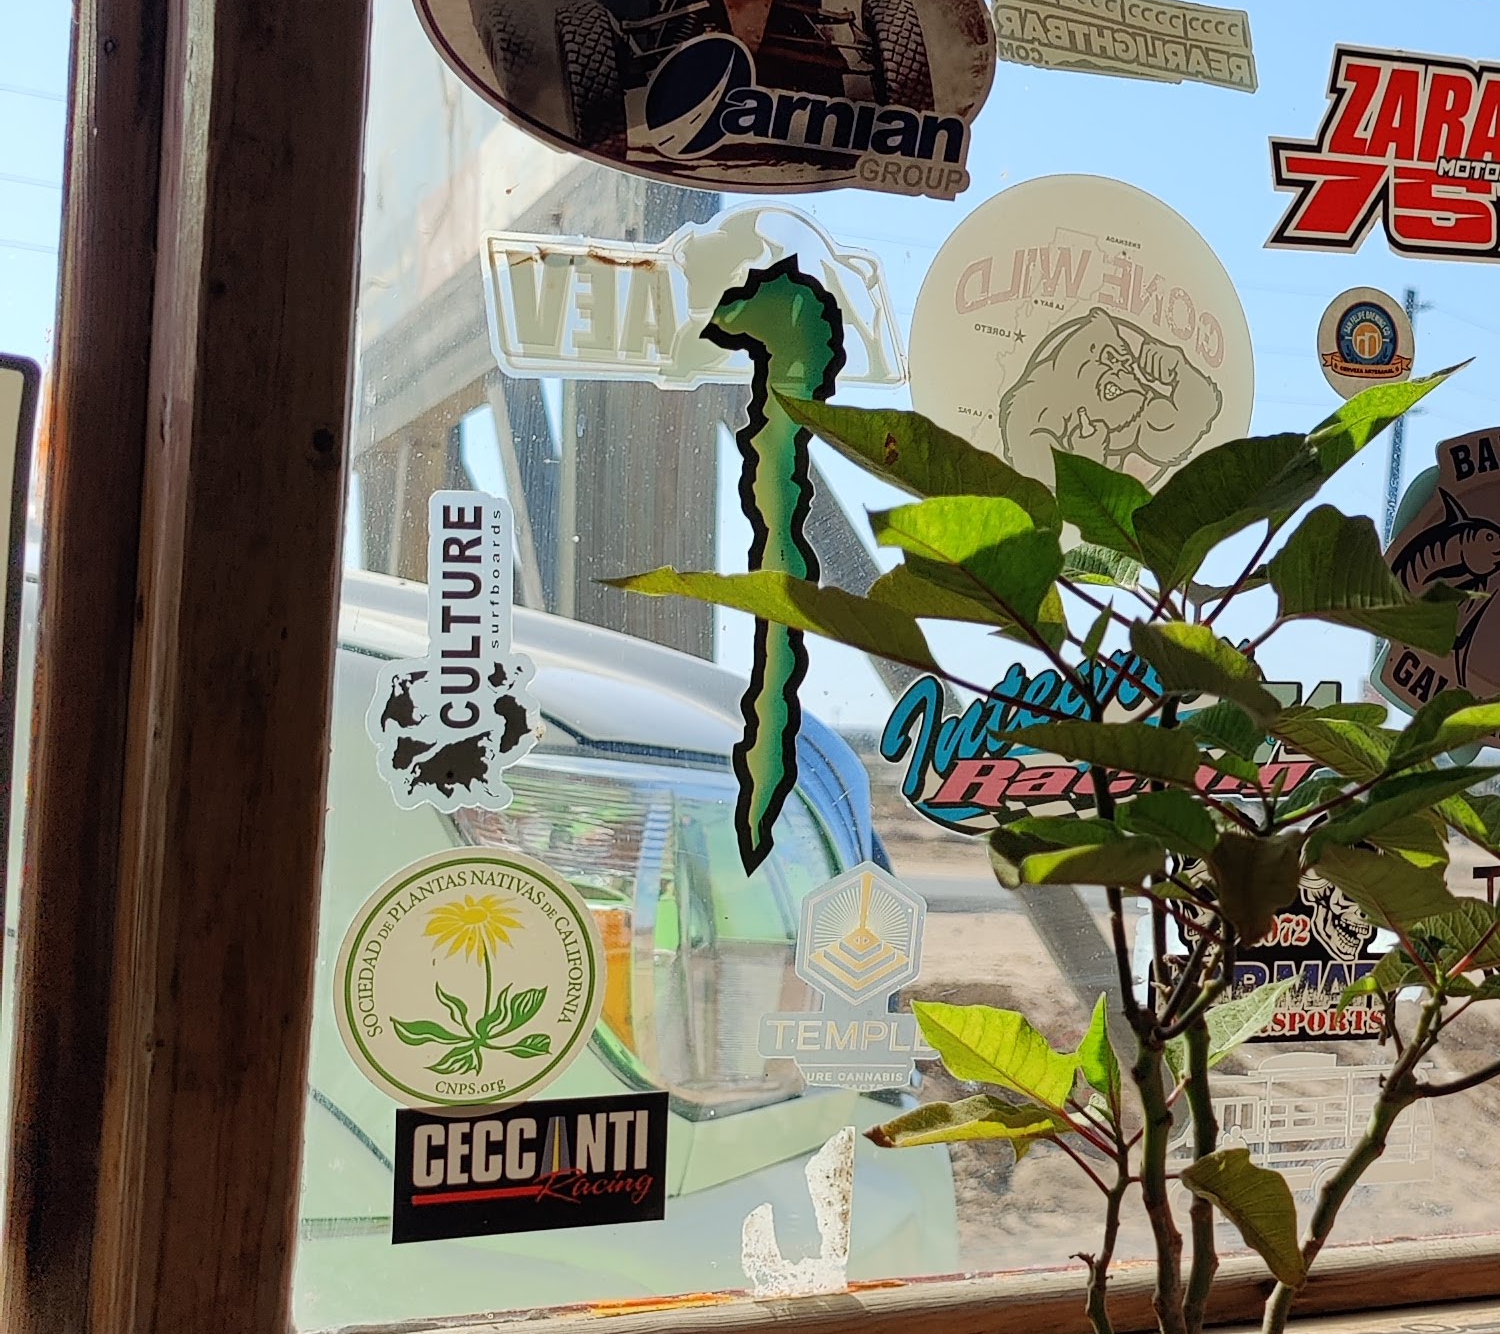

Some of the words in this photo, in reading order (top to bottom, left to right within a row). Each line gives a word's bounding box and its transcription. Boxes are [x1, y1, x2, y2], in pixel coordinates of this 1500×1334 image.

[719, 86, 966, 164] arnian
[859, 155, 965, 193] GROUP
[490, 508, 503, 650] surfboards
[438, 504, 484, 730] CULTURE
[356, 939, 384, 1039] SOCIEDAD
[389, 869, 468, 924] PLANTAS
[470, 868, 546, 907] NATIVAS
[555, 915, 585, 1027] CALIFORNIA
[434, 1077, 507, 1096] CNPS.org
[837, 1071, 904, 1083] CANNABIS
[530, 1167, 654, 1206] Racing
